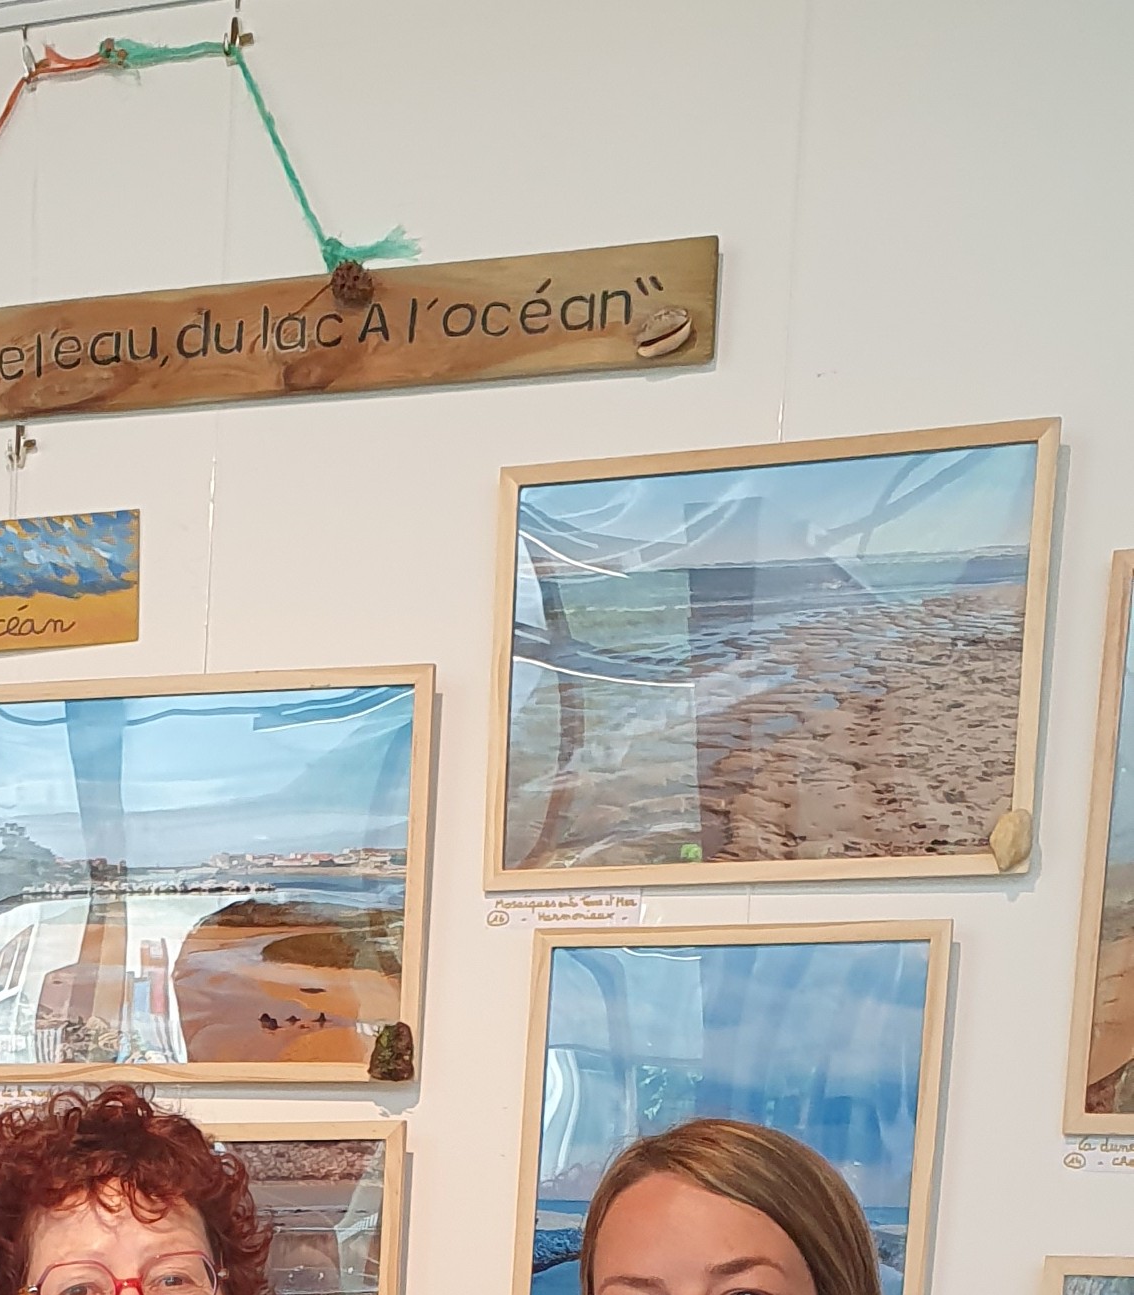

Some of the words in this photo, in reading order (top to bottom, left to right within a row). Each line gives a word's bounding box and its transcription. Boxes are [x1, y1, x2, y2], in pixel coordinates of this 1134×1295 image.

[176, 309, 244, 359] du
[261, 304, 343, 352] lac
[358, 301, 390, 343] A
